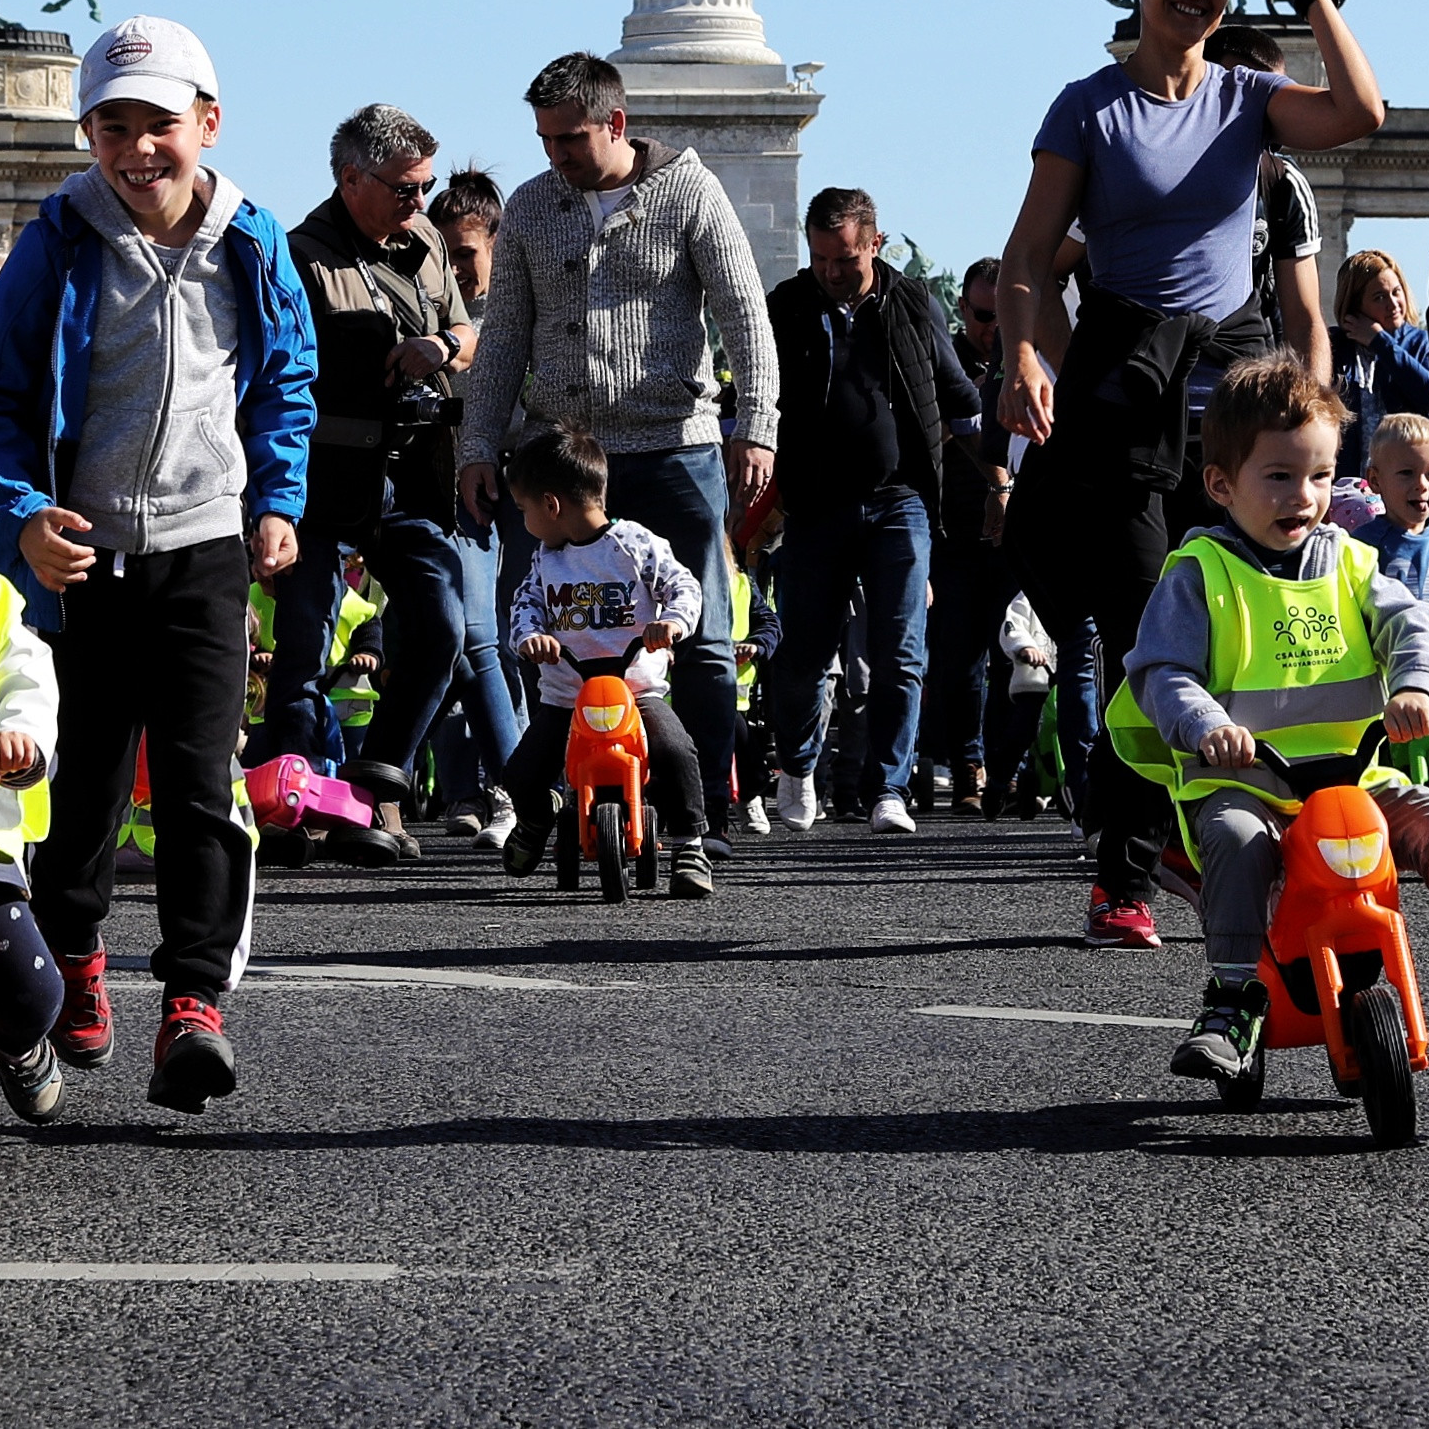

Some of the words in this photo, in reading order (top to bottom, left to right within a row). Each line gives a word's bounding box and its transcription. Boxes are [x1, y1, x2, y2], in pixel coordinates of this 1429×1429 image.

[547, 580, 636, 607] MICKEY
[548, 605, 636, 631] MOUSE
[1275, 646, 1343, 660] CSALÁDBARÁT
[1282, 658, 1340, 669] MAGYARORSZÁG
